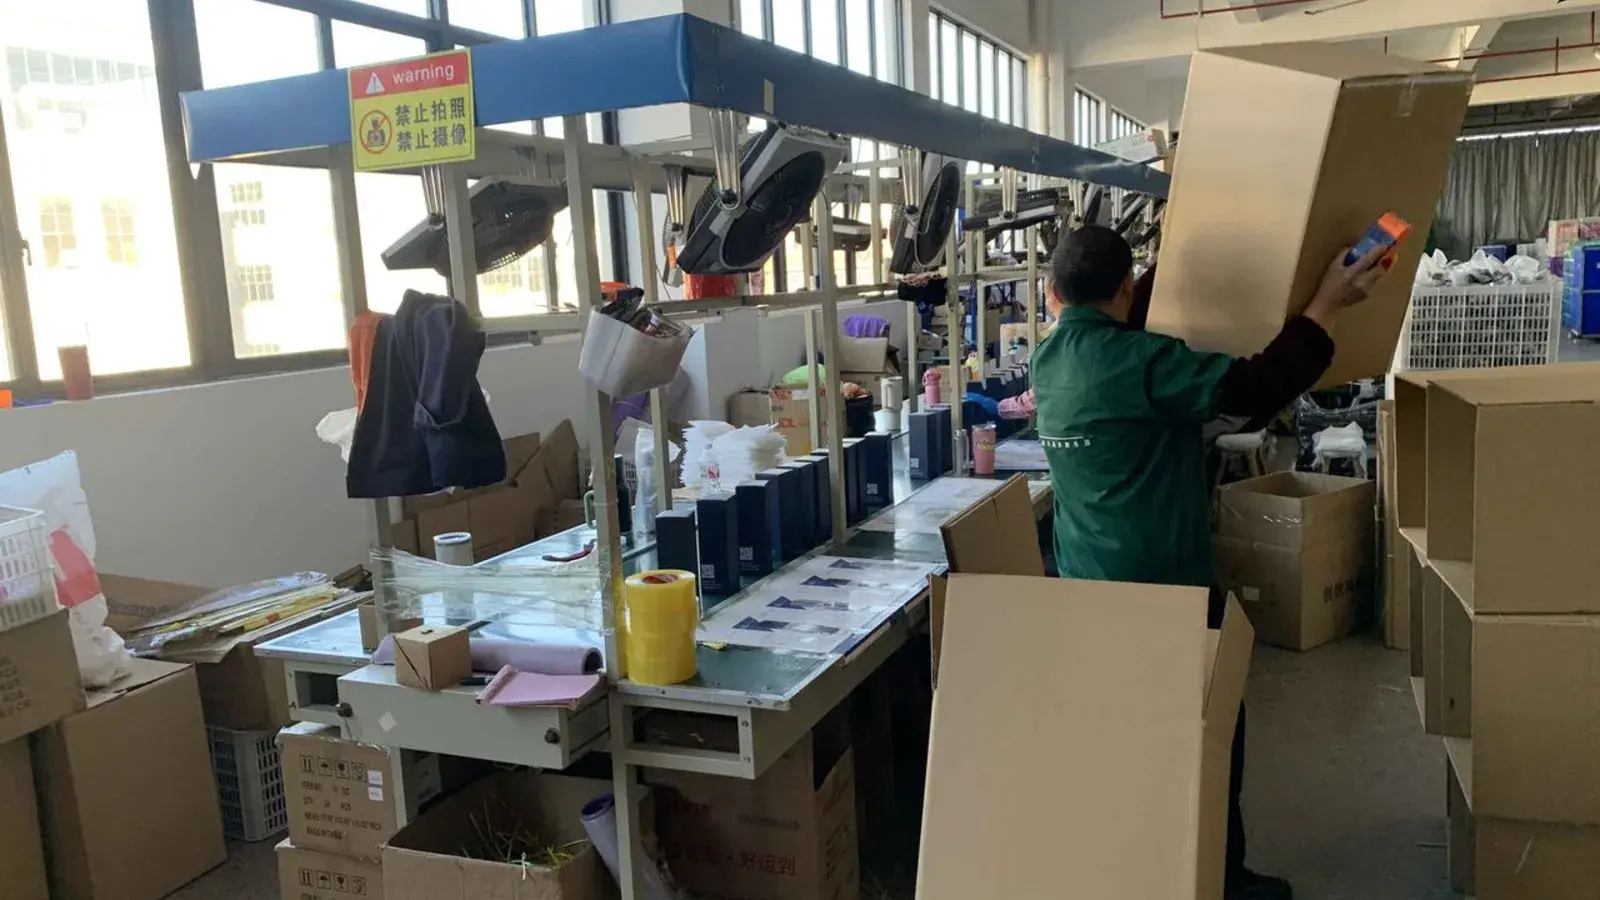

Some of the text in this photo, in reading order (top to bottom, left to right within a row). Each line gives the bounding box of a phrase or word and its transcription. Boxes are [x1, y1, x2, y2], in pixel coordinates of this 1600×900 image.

[392, 64, 455, 85] warning
[395, 97, 466, 126] 禁止拍照
[396, 123, 467, 152] 禁止摄像
